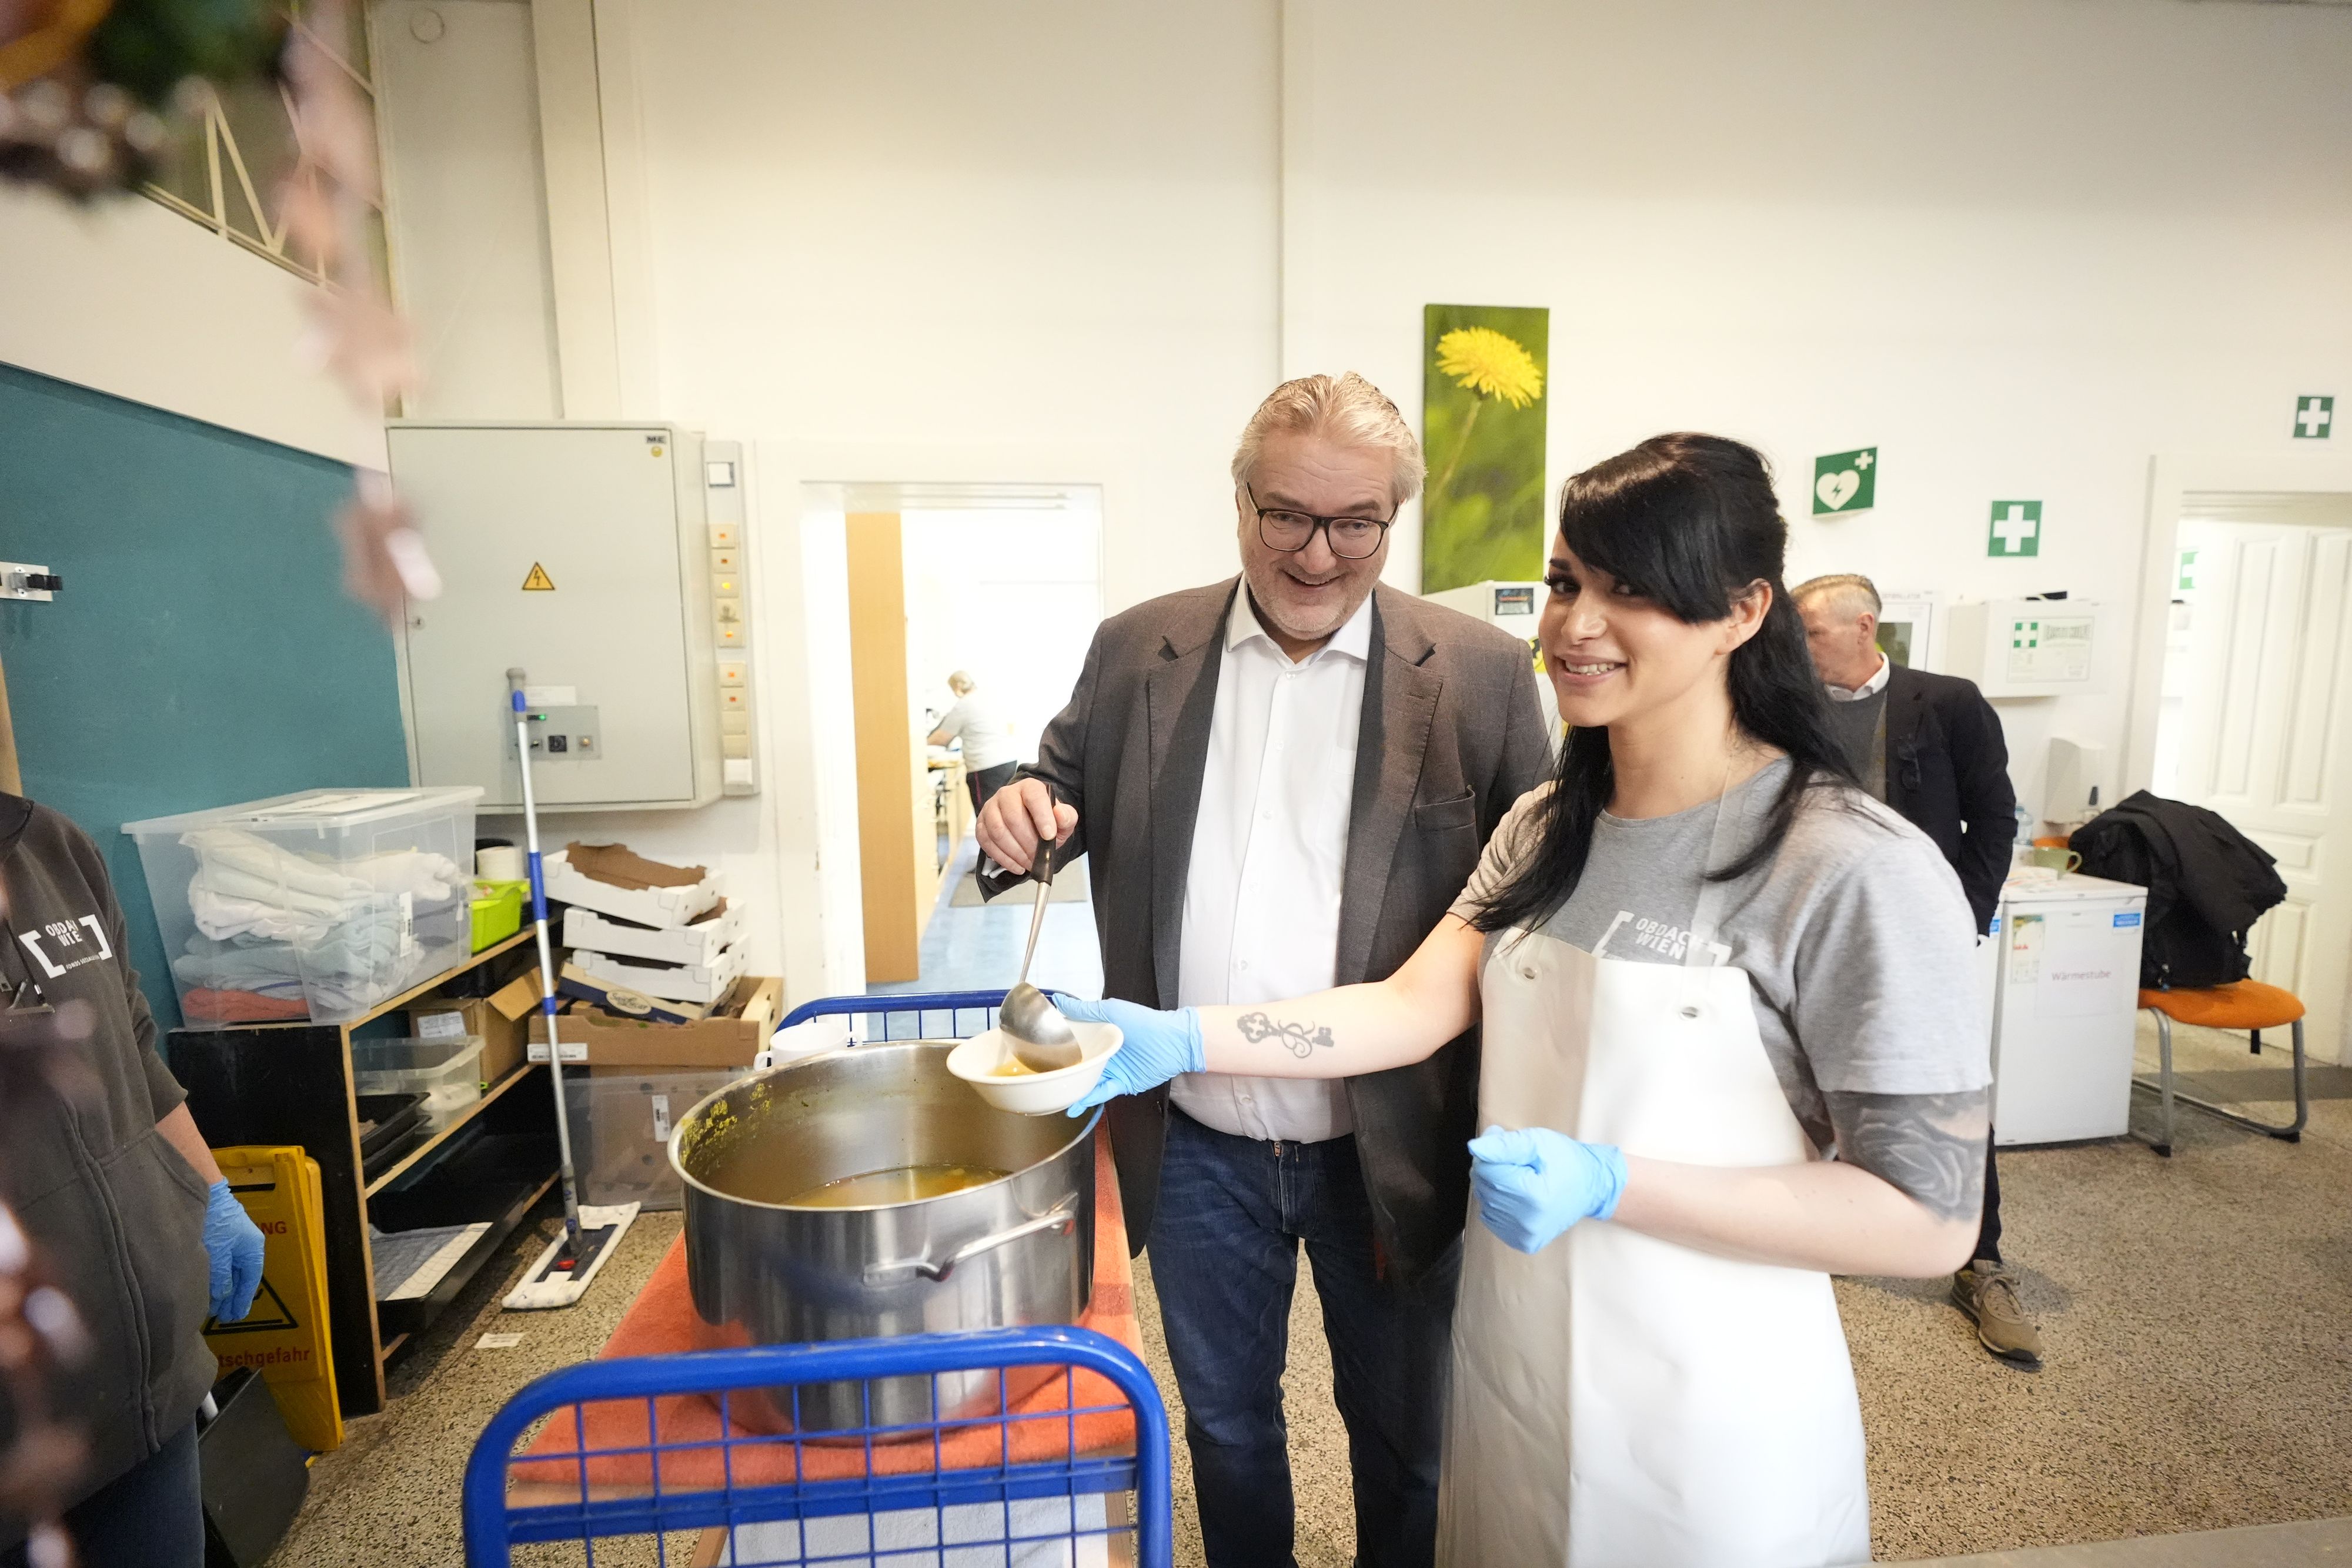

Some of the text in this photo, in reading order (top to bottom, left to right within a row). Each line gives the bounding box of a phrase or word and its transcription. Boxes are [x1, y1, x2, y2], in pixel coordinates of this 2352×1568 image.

[45, 920, 78, 936] OBDA
[58, 931, 82, 946] WIE
[1636, 932, 1686, 960] WIEN
[2052, 970, 2112, 981] Wärmestube
[218, 1346, 310, 1368] tschgefahr
